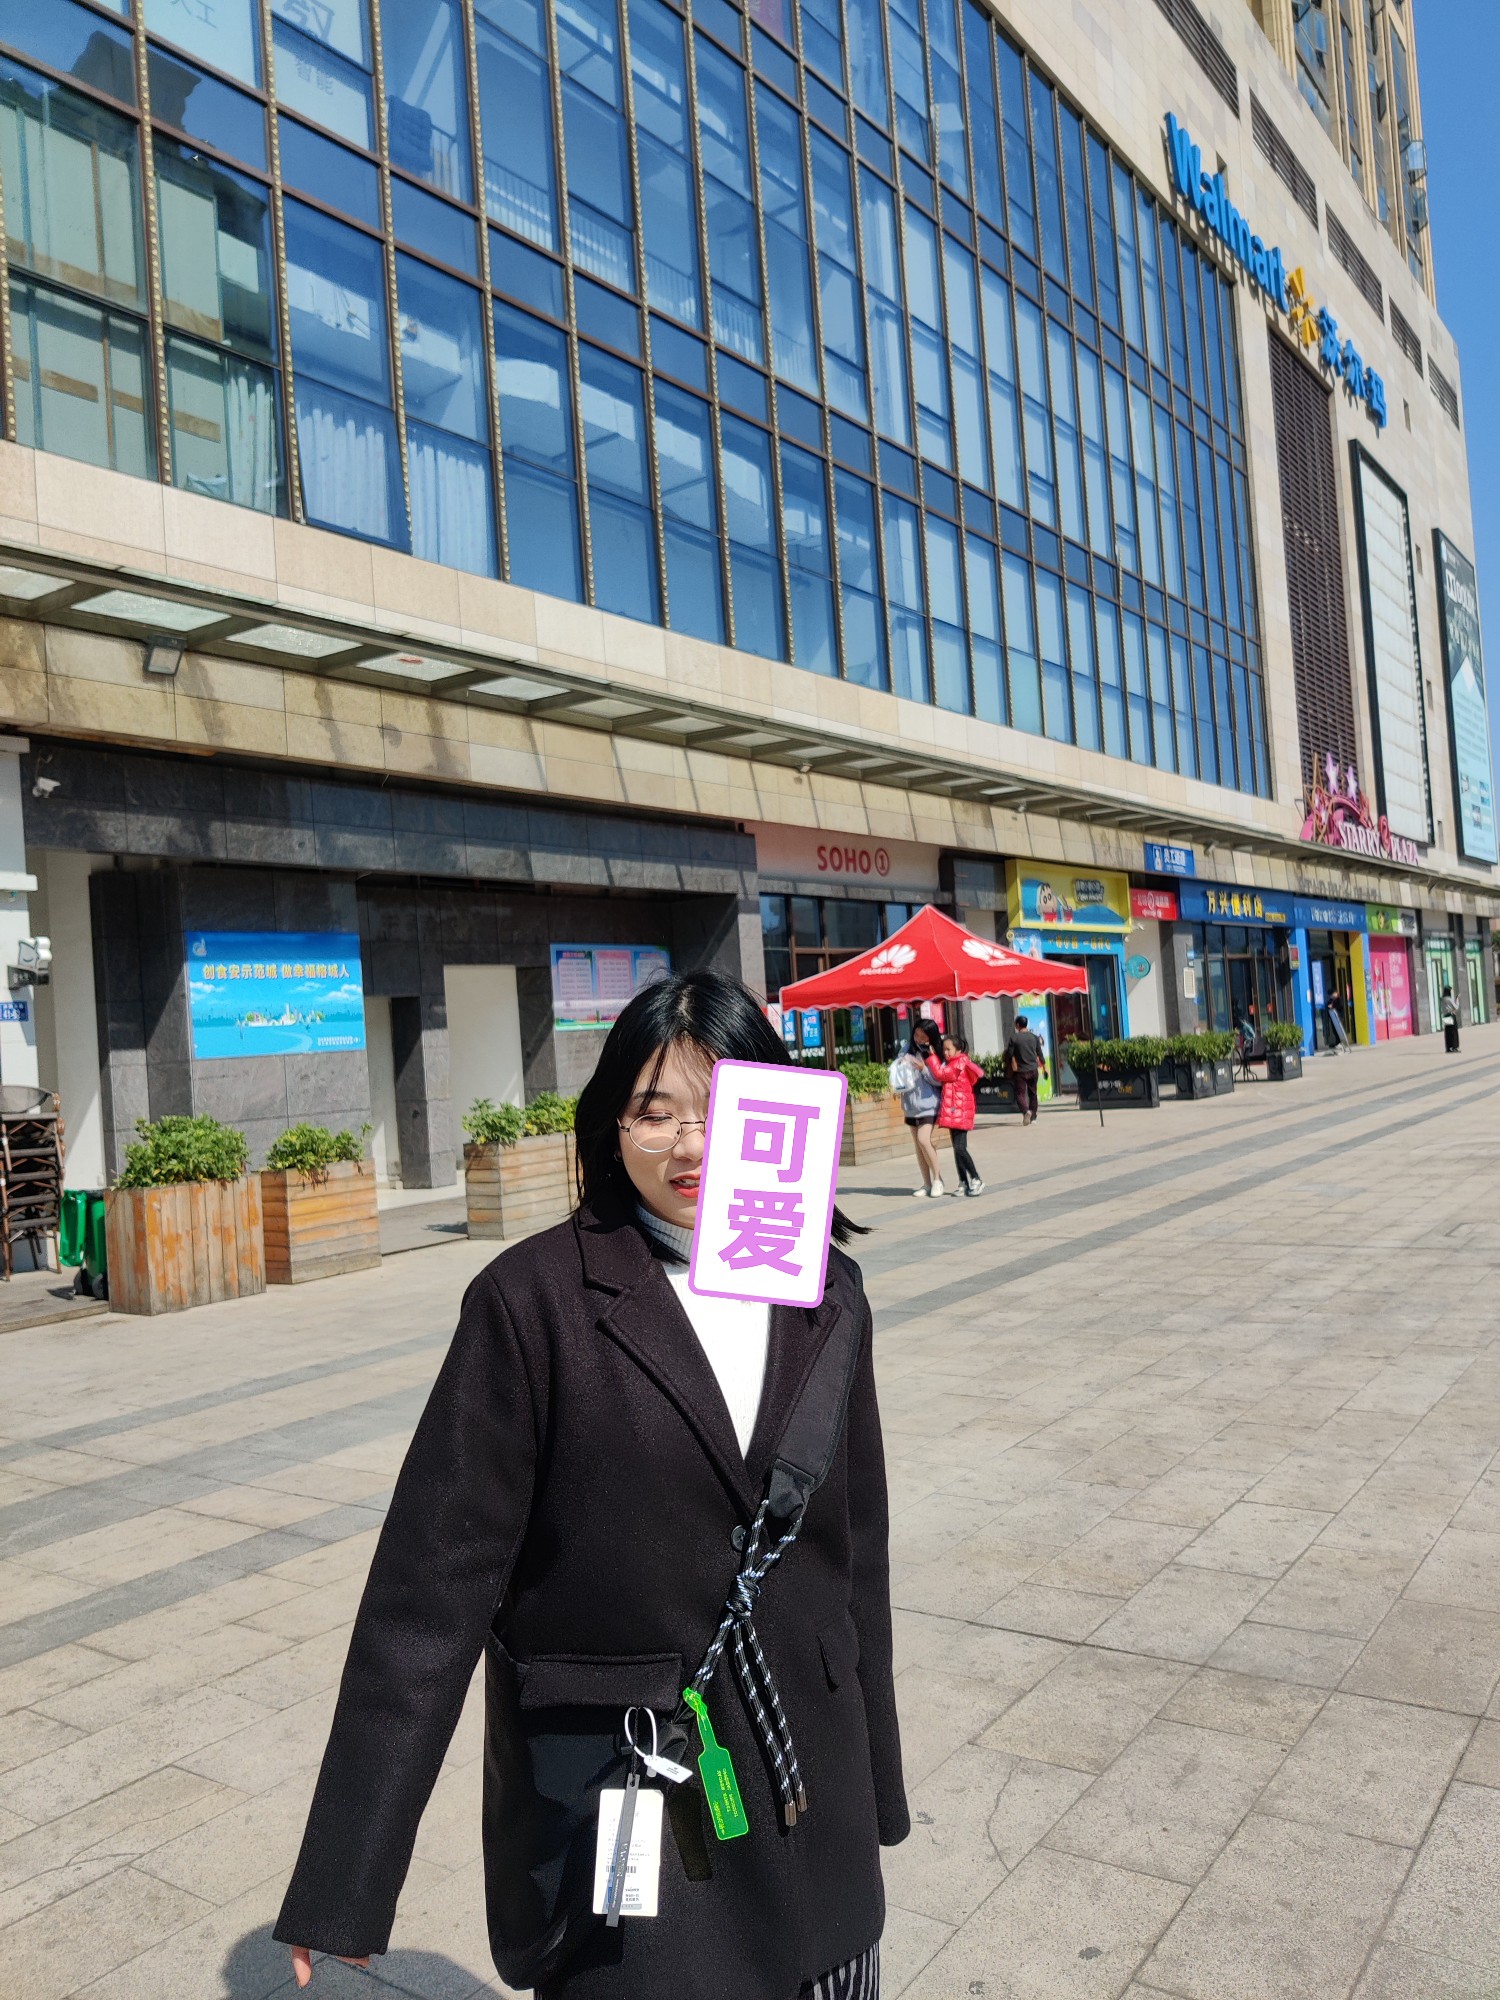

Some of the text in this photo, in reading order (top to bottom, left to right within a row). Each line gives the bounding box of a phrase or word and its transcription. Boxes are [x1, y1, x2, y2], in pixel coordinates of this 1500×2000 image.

[1164, 111, 1289, 314] Walmart
[817, 846, 871, 874] SOHO
[1338, 821, 1419, 865] STARRY PLAZA
[203, 964, 278, 980] 创食安示范城
